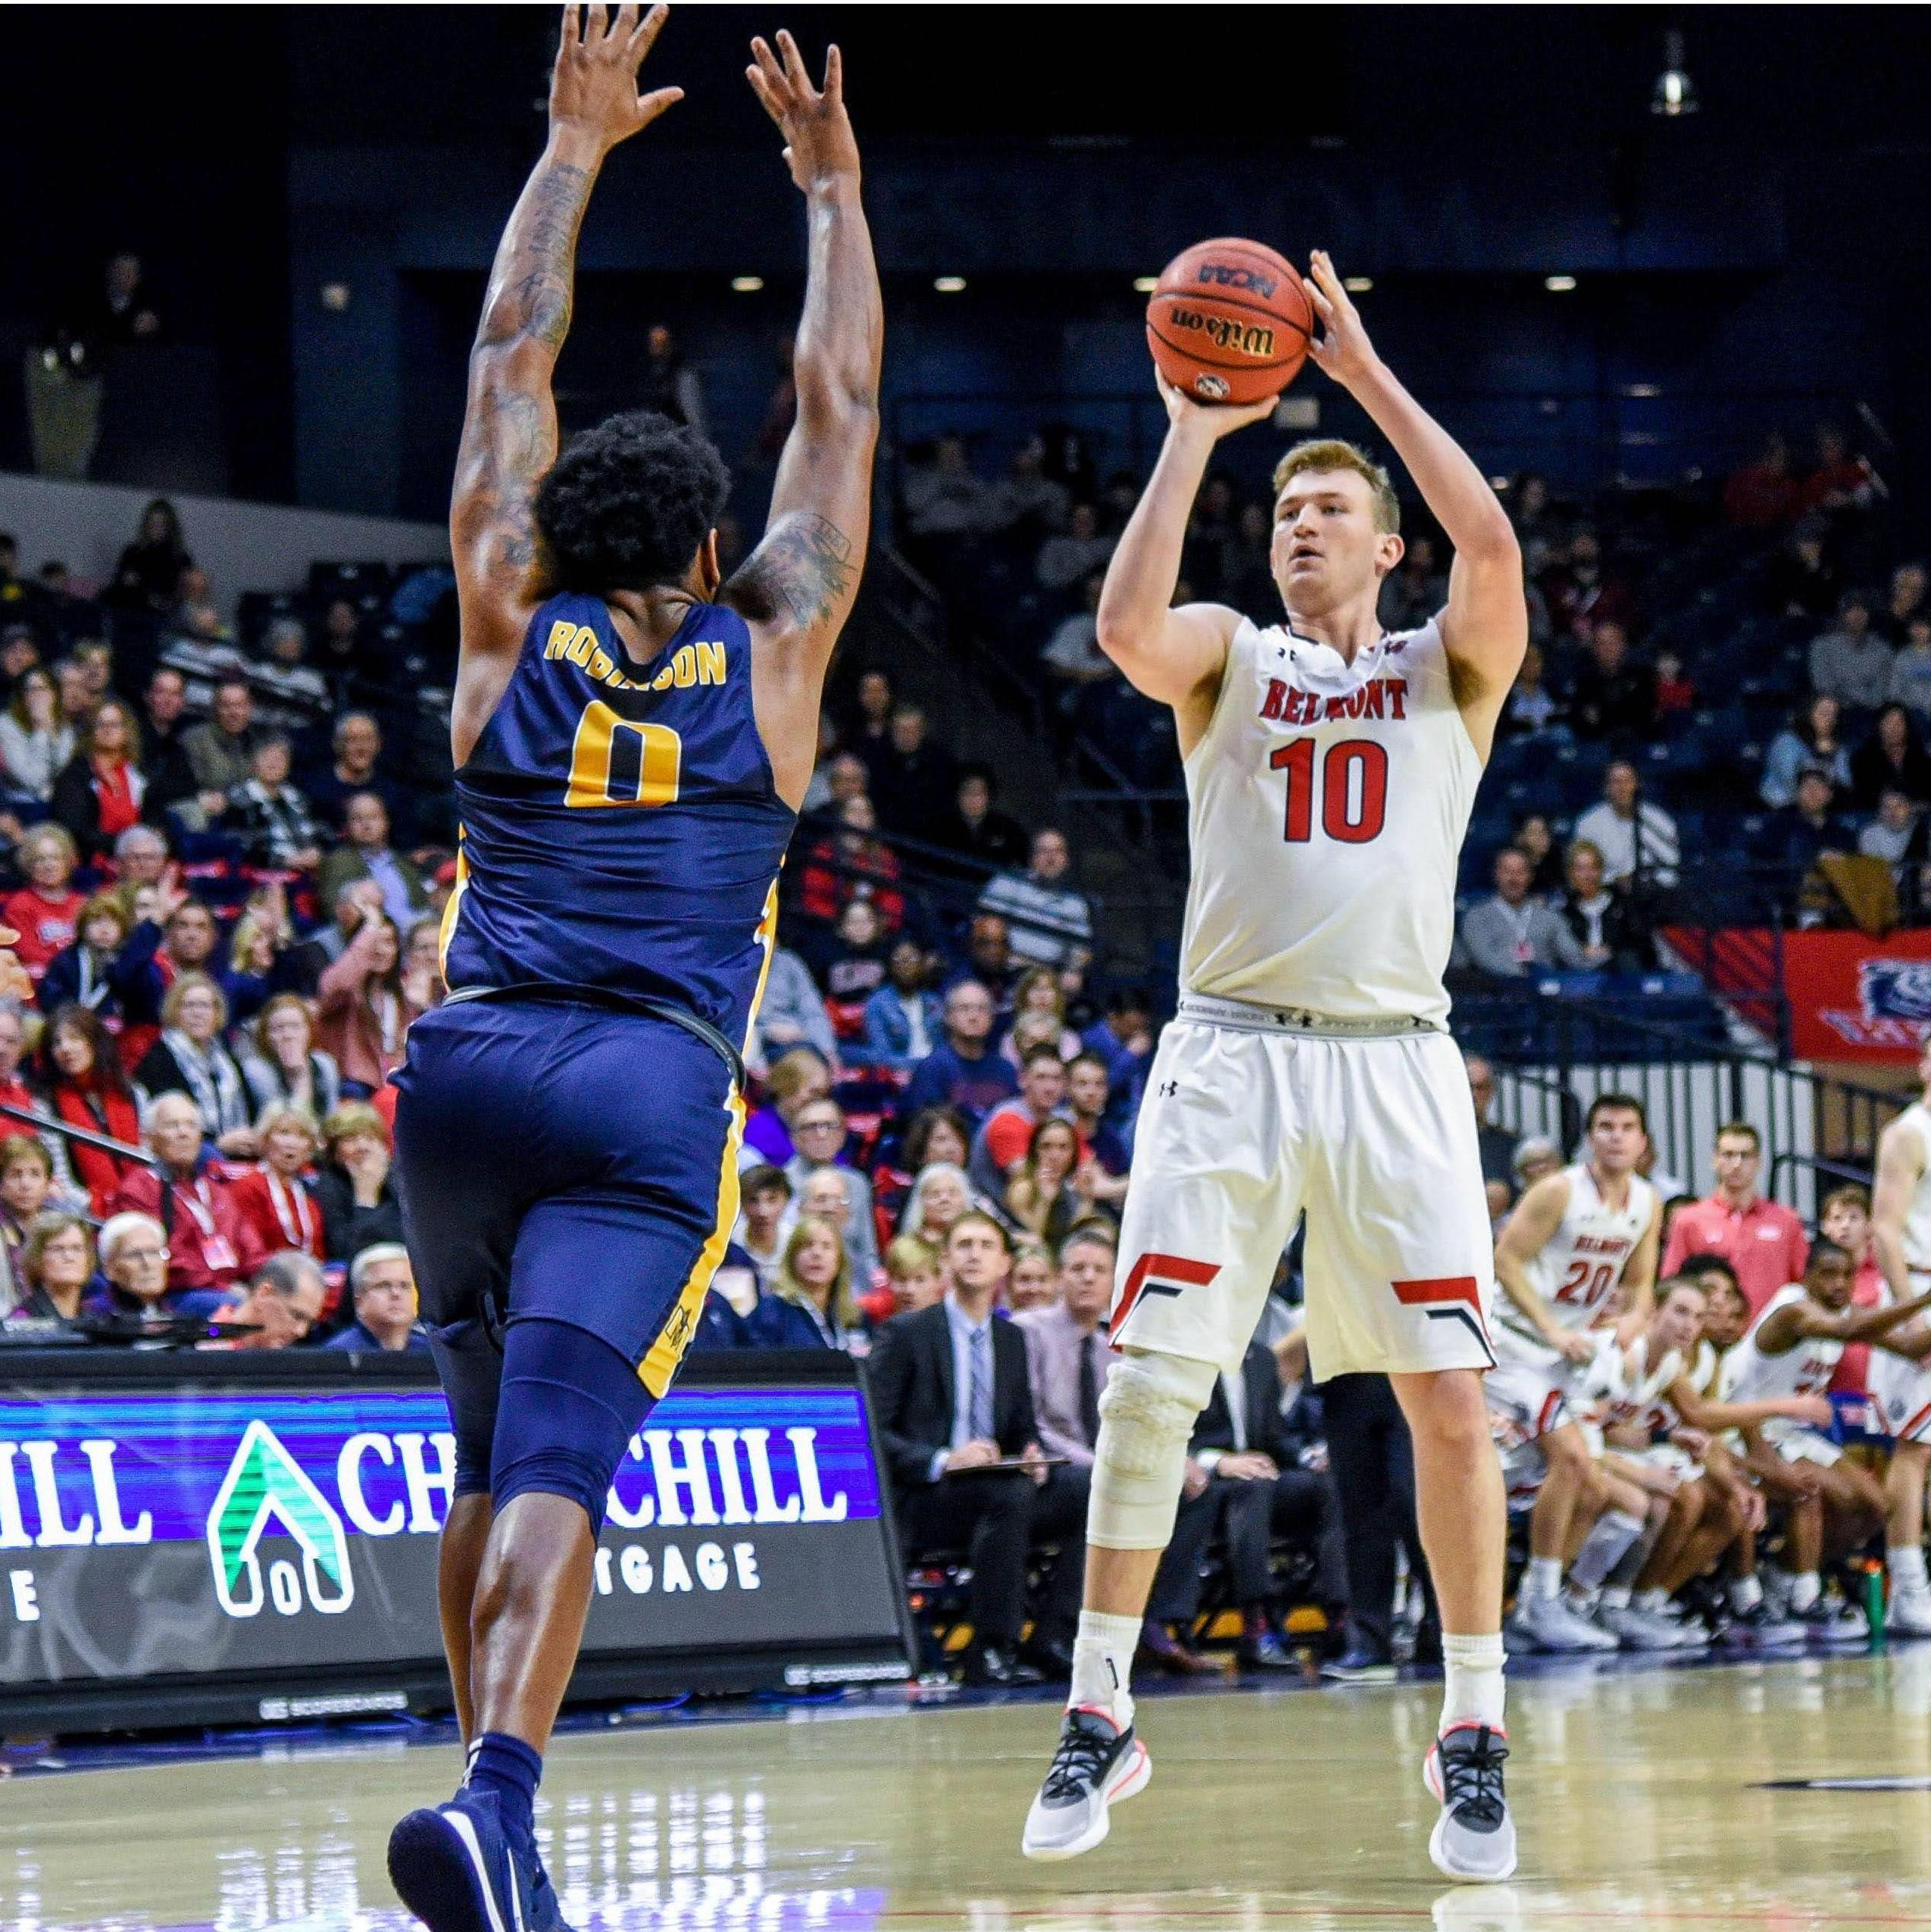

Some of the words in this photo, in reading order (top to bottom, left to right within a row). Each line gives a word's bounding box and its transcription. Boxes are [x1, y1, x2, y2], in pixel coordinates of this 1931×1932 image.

[1171, 307, 1274, 356] Wilson
[543, 620, 726, 691] ROBSON
[564, 699, 682, 808] 0
[1270, 738, 1389, 844] 10
[1554, 1259, 1614, 1305] 20
[337, 1427, 847, 1537] CHCHILL
[594, 1541, 761, 1596] TGAGE
